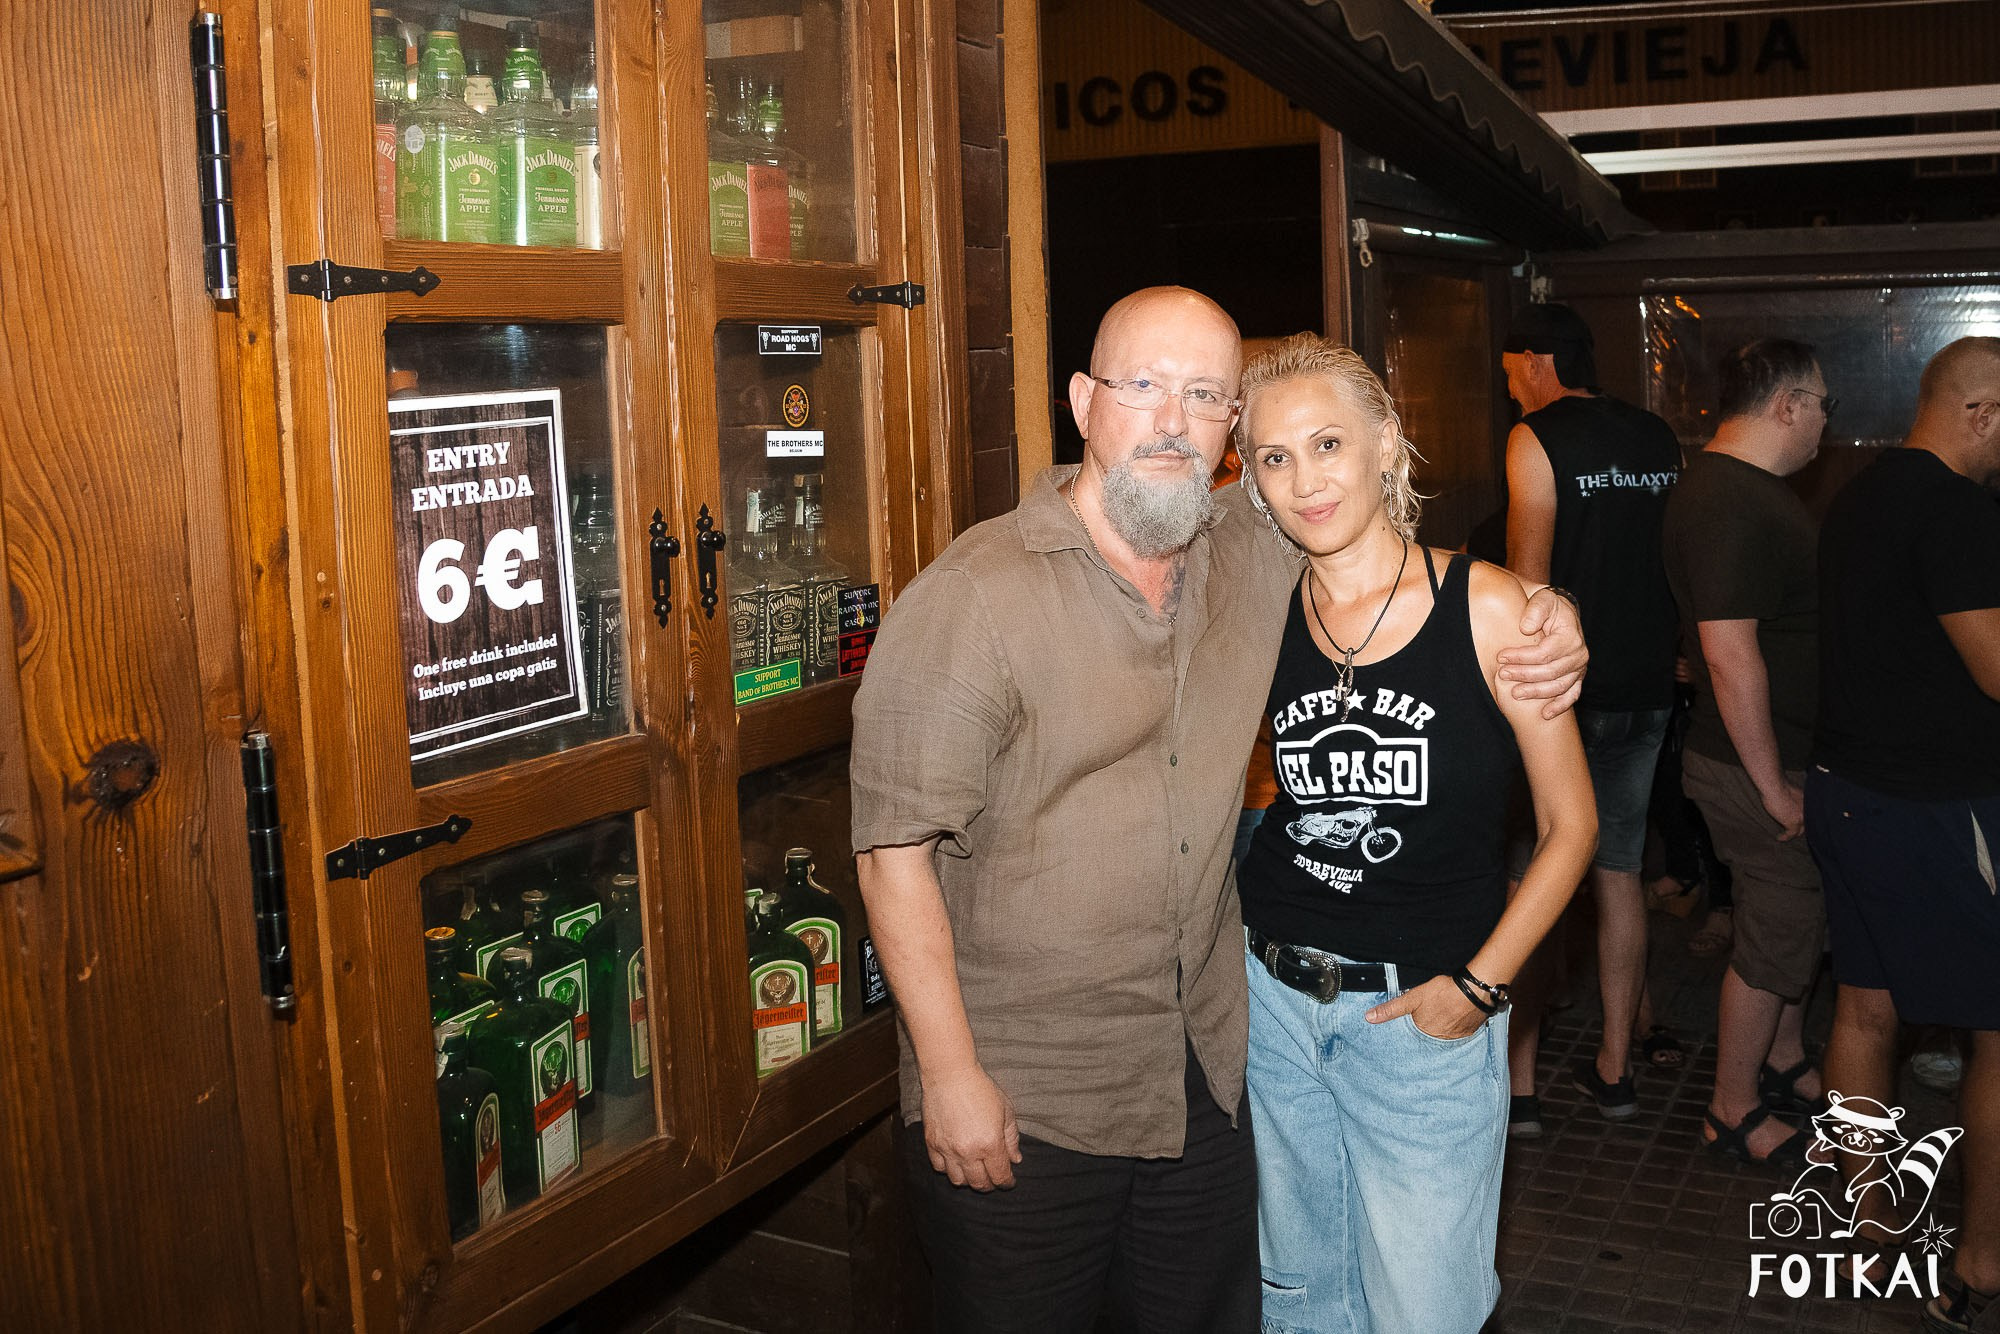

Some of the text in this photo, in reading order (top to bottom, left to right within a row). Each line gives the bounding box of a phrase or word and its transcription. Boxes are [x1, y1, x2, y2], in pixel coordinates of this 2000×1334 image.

[1468, 19, 1809, 91] EVIEJA
[1054, 66, 1228, 129] ICOS
[448, 153, 468, 172] JACK
[468, 150, 498, 176] DANIEL'S
[525, 153, 546, 173] JACK
[711, 170, 748, 195] JACK DANIEL
[459, 193, 491, 204] Tennessee
[535, 192, 569, 204] Tennessee
[460, 204, 491, 214] APPLE
[538, 204, 567, 214] APPLE
[721, 220, 743, 228] APPLE
[771, 335, 810, 343] ROAD HOGS
[785, 343, 797, 352] MC
[427, 441, 511, 473] ENTRY
[1575, 474, 1609, 490] THE
[411, 474, 535, 512] ENTRADA
[417, 525, 545, 624] 6€
[819, 587, 833, 606] JACK
[770, 599, 785, 615] JACK
[809, 611, 814, 620] IN
[606, 612, 621, 634] JAC
[759, 621, 765, 630] IN
[774, 633, 801, 643] Tennessee
[822, 634, 838, 643] WHIS
[413, 632, 558, 679] One free drink included
[772, 643, 802, 654] WHISKEY
[418, 656, 558, 701] Incluye una copa gatis
[754, 668, 781, 683] SUPPORT
[737, 688, 753, 699] BAND
[761, 678, 790, 693] BROTHERS
[790, 676, 798, 686] MC
[1273, 687, 1436, 735] CAFE BAR
[1281, 750, 1417, 796] EL PASO
